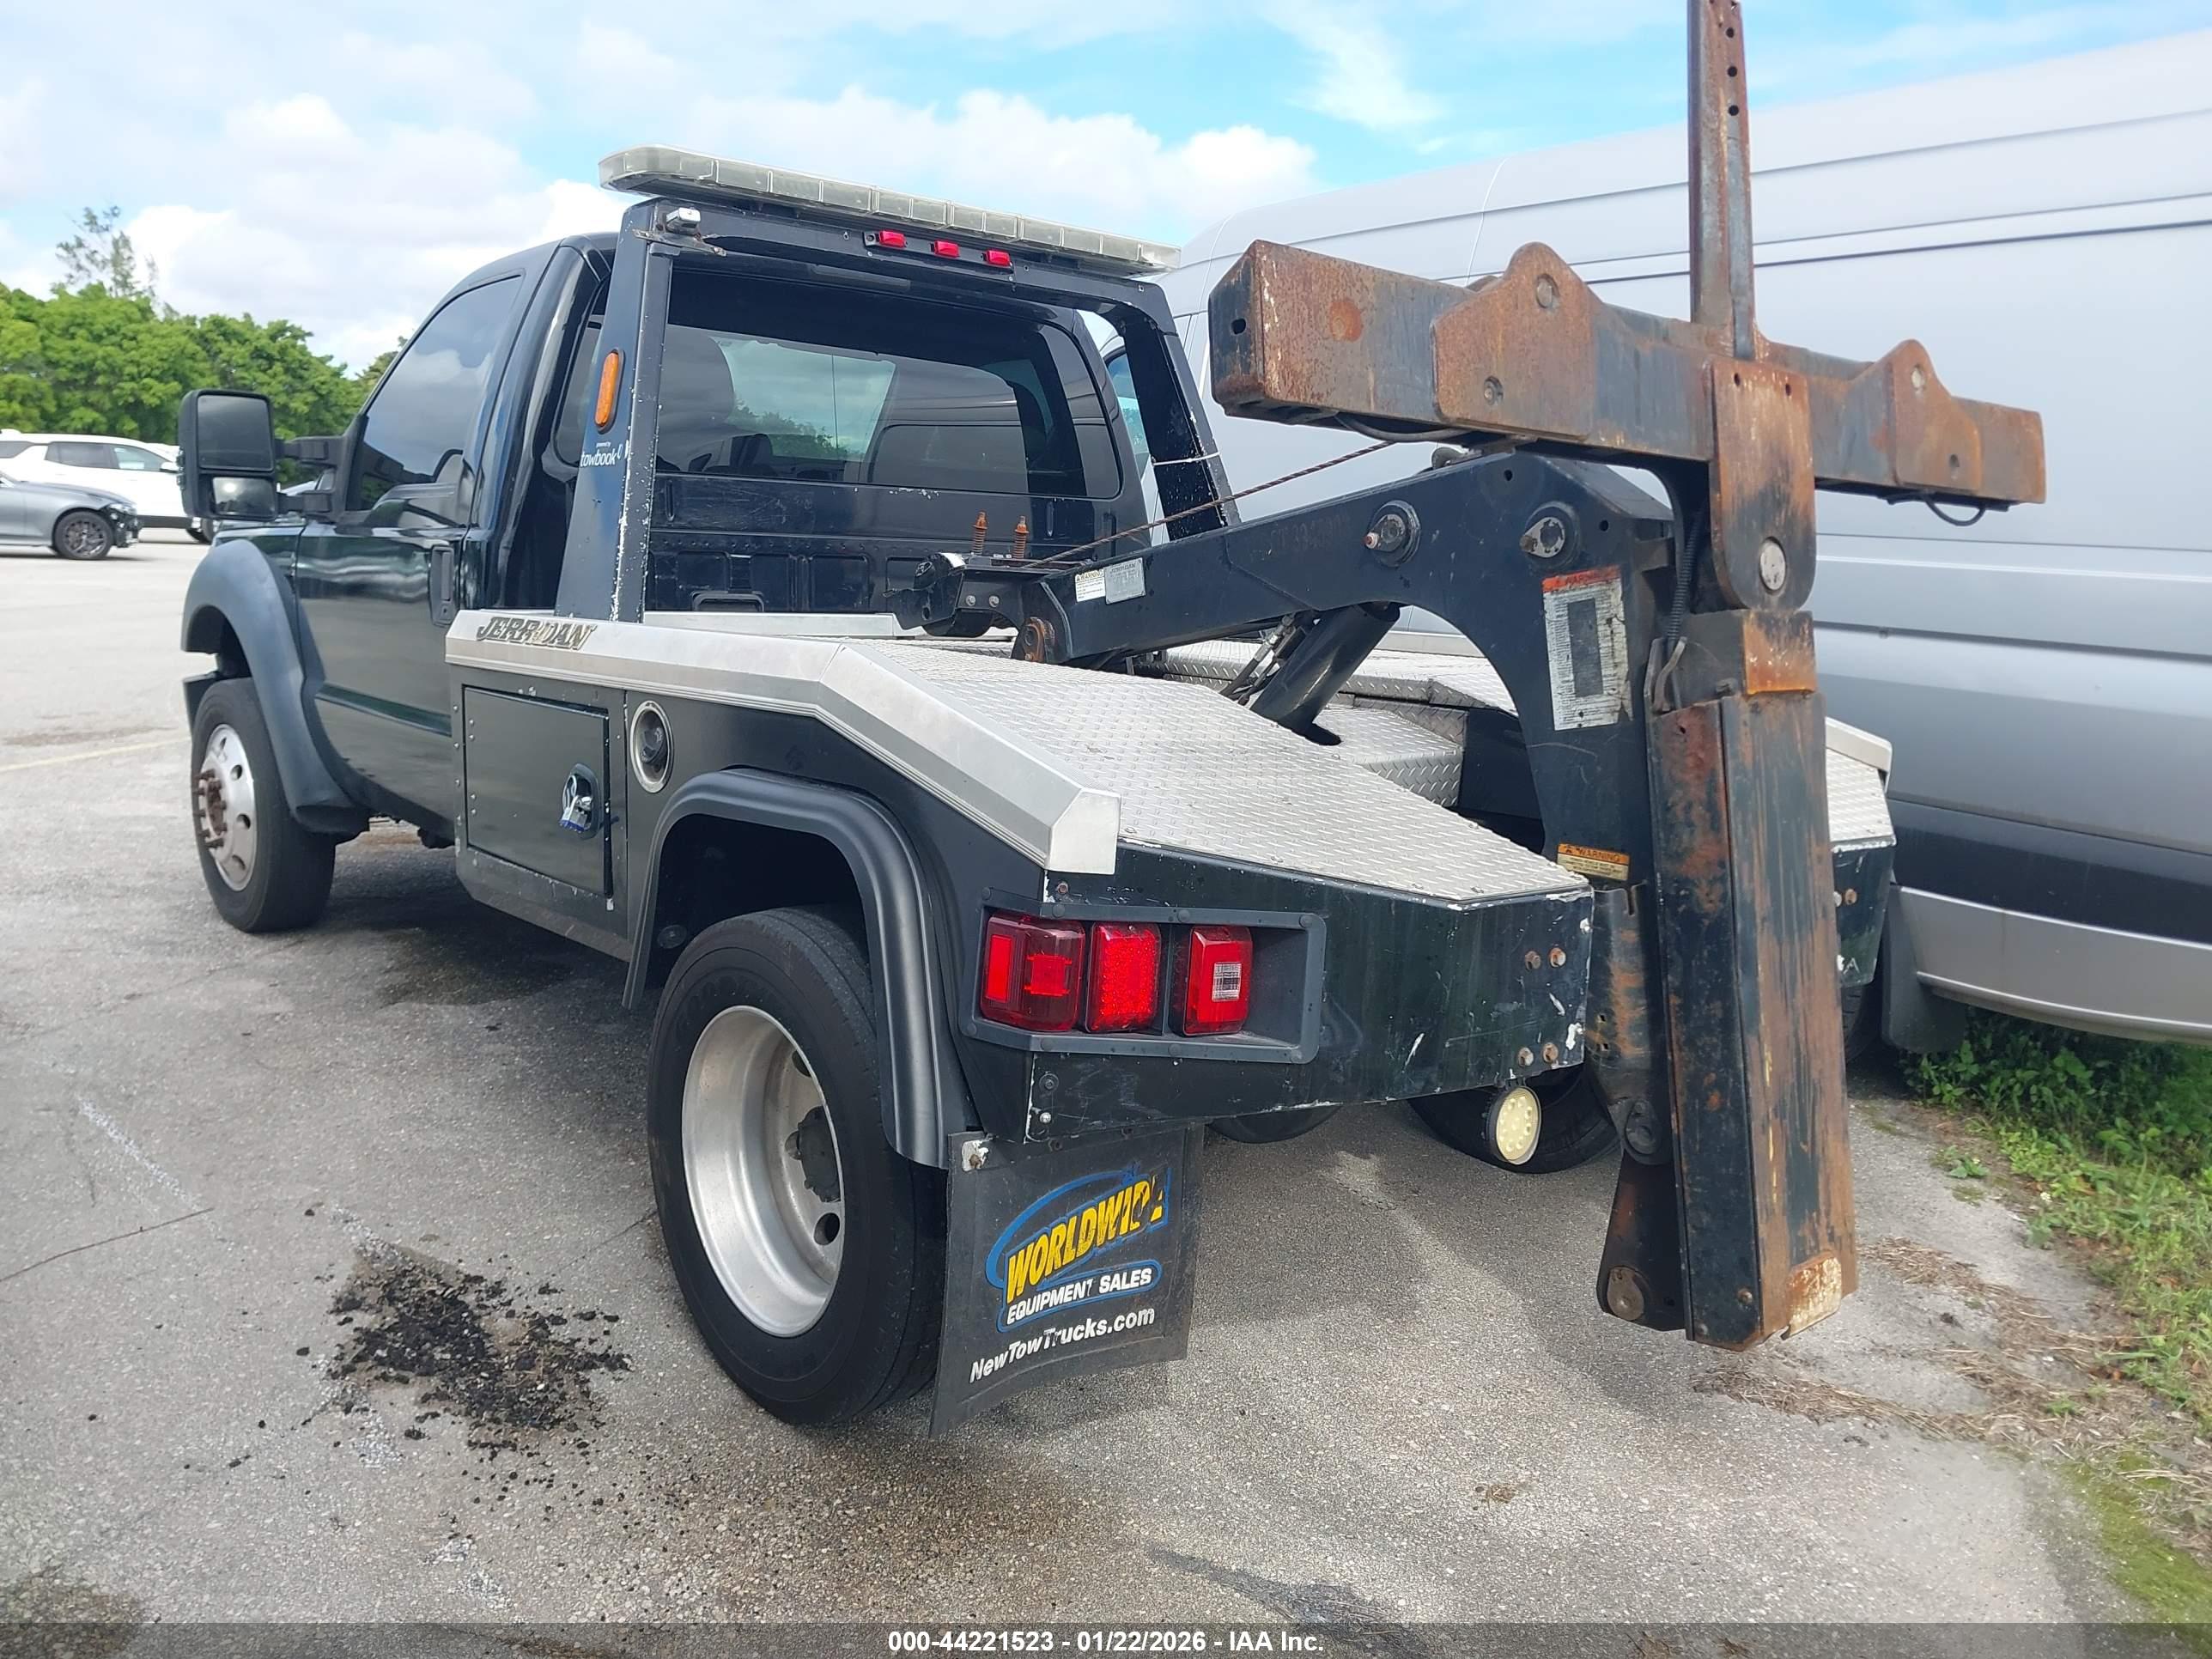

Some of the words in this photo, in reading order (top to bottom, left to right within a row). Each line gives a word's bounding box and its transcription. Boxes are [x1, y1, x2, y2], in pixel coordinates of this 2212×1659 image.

[580, 447, 617, 467] towbook
[1578, 847, 1620, 862] WARNING
[1098, 1267, 1152, 1294] SALES
[969, 1306, 1155, 1383] NewTowTrucks.com
